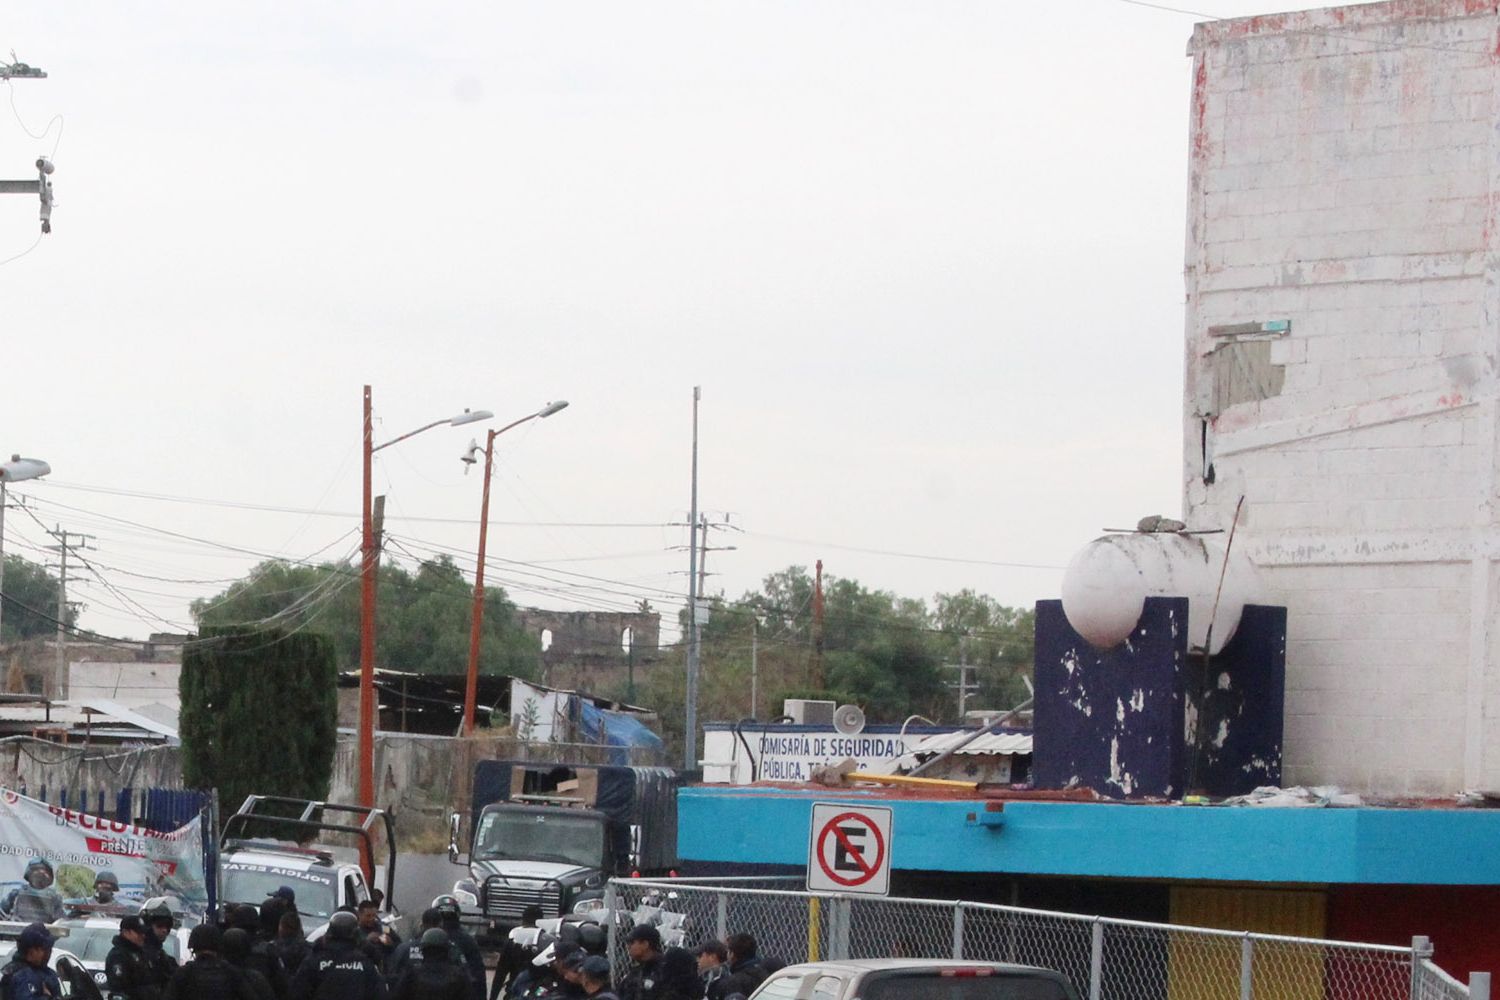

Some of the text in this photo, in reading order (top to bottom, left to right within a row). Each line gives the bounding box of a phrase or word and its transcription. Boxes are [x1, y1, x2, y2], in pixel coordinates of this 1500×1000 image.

[759, 735, 905, 758] COMISARÍA DE SEGURIDAD
[26, 847, 40, 857] DE
[55, 852, 63, 861] A
[835, 827, 867, 872] E
